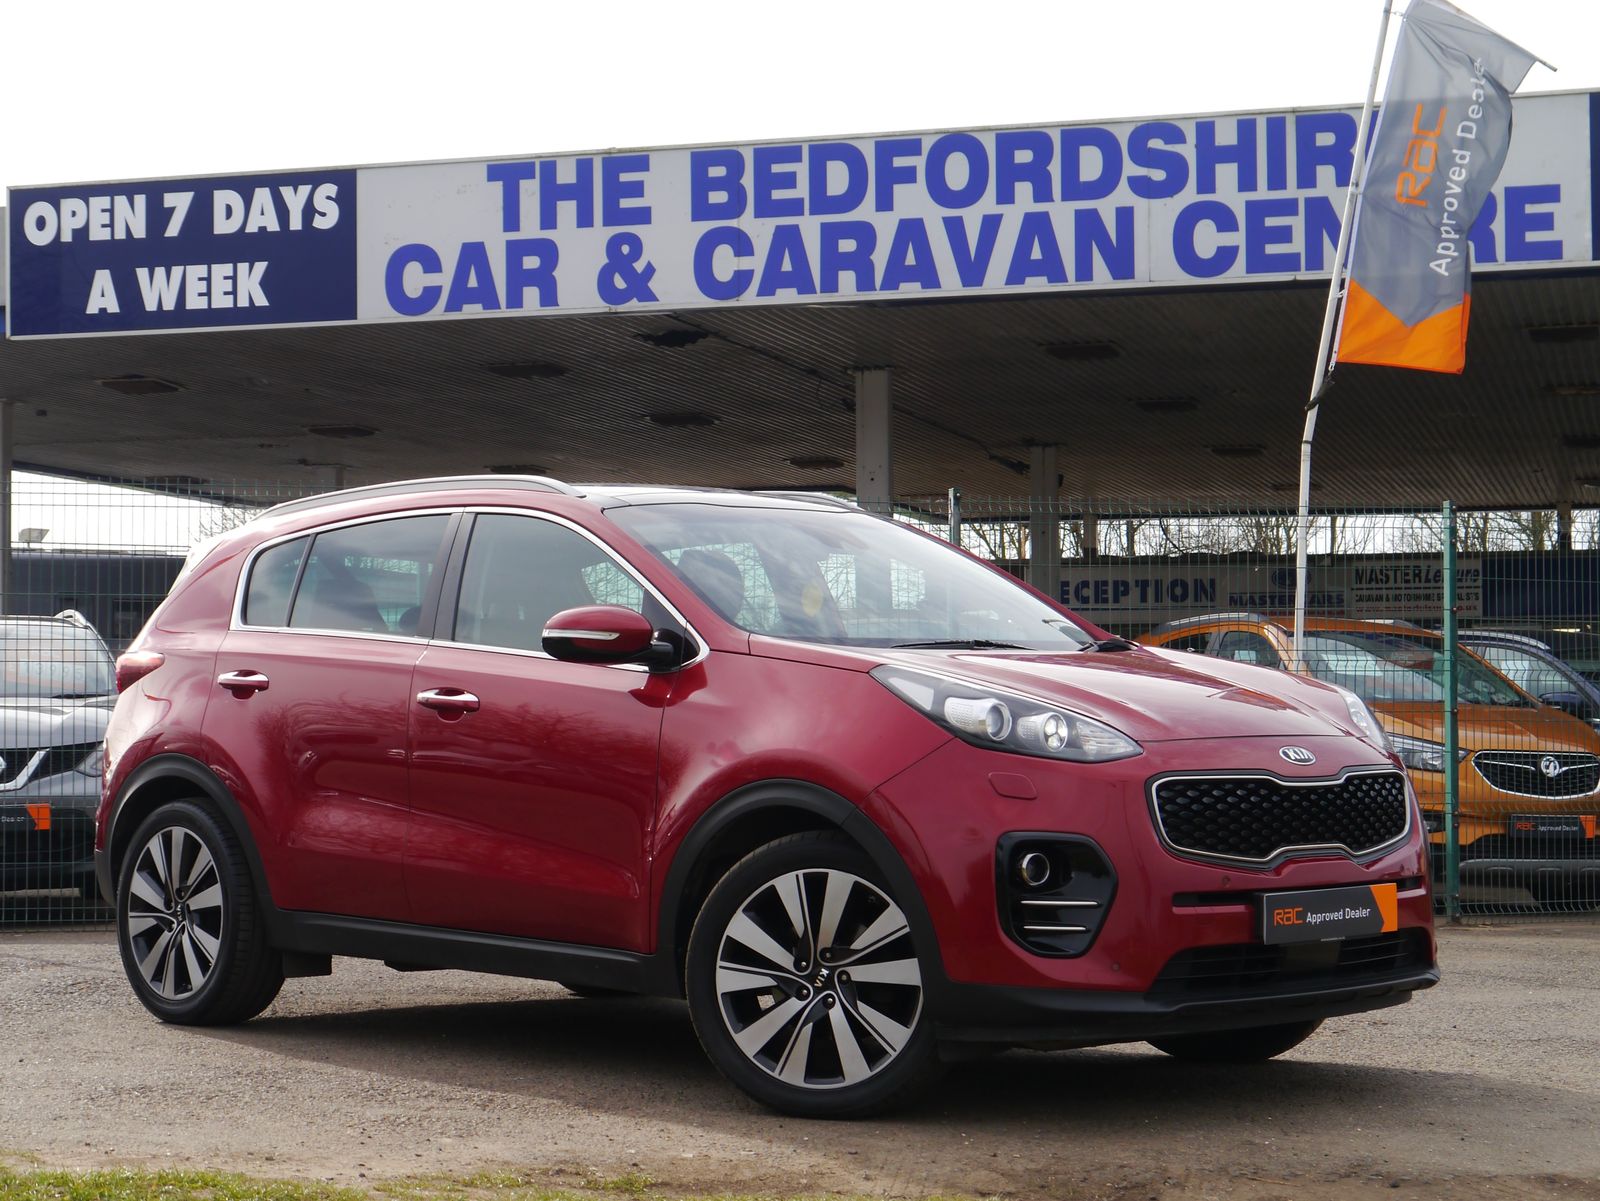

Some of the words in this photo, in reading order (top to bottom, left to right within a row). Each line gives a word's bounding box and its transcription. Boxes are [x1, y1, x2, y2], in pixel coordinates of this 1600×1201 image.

[23, 194, 147, 246] OPEN
[163, 191, 195, 237] 7
[212, 183, 340, 235] DAYS
[486, 153, 652, 233] THE
[1429, 149, 1472, 276] Approved
[385, 237, 560, 317] CAR
[596, 231, 660, 306] &
[693, 205, 1136, 301] CARAVAN
[1172, 184, 1563, 279] CENRE
[85, 269, 120, 314] A
[135, 261, 270, 312] WEEK
[1060, 578, 1216, 605] ECEPTION
[1284, 748, 1314, 760] KIA
[1306, 909, 1343, 925] Approved
[1345, 907, 1371, 919] Dealer
[814, 968, 829, 987] KIA
